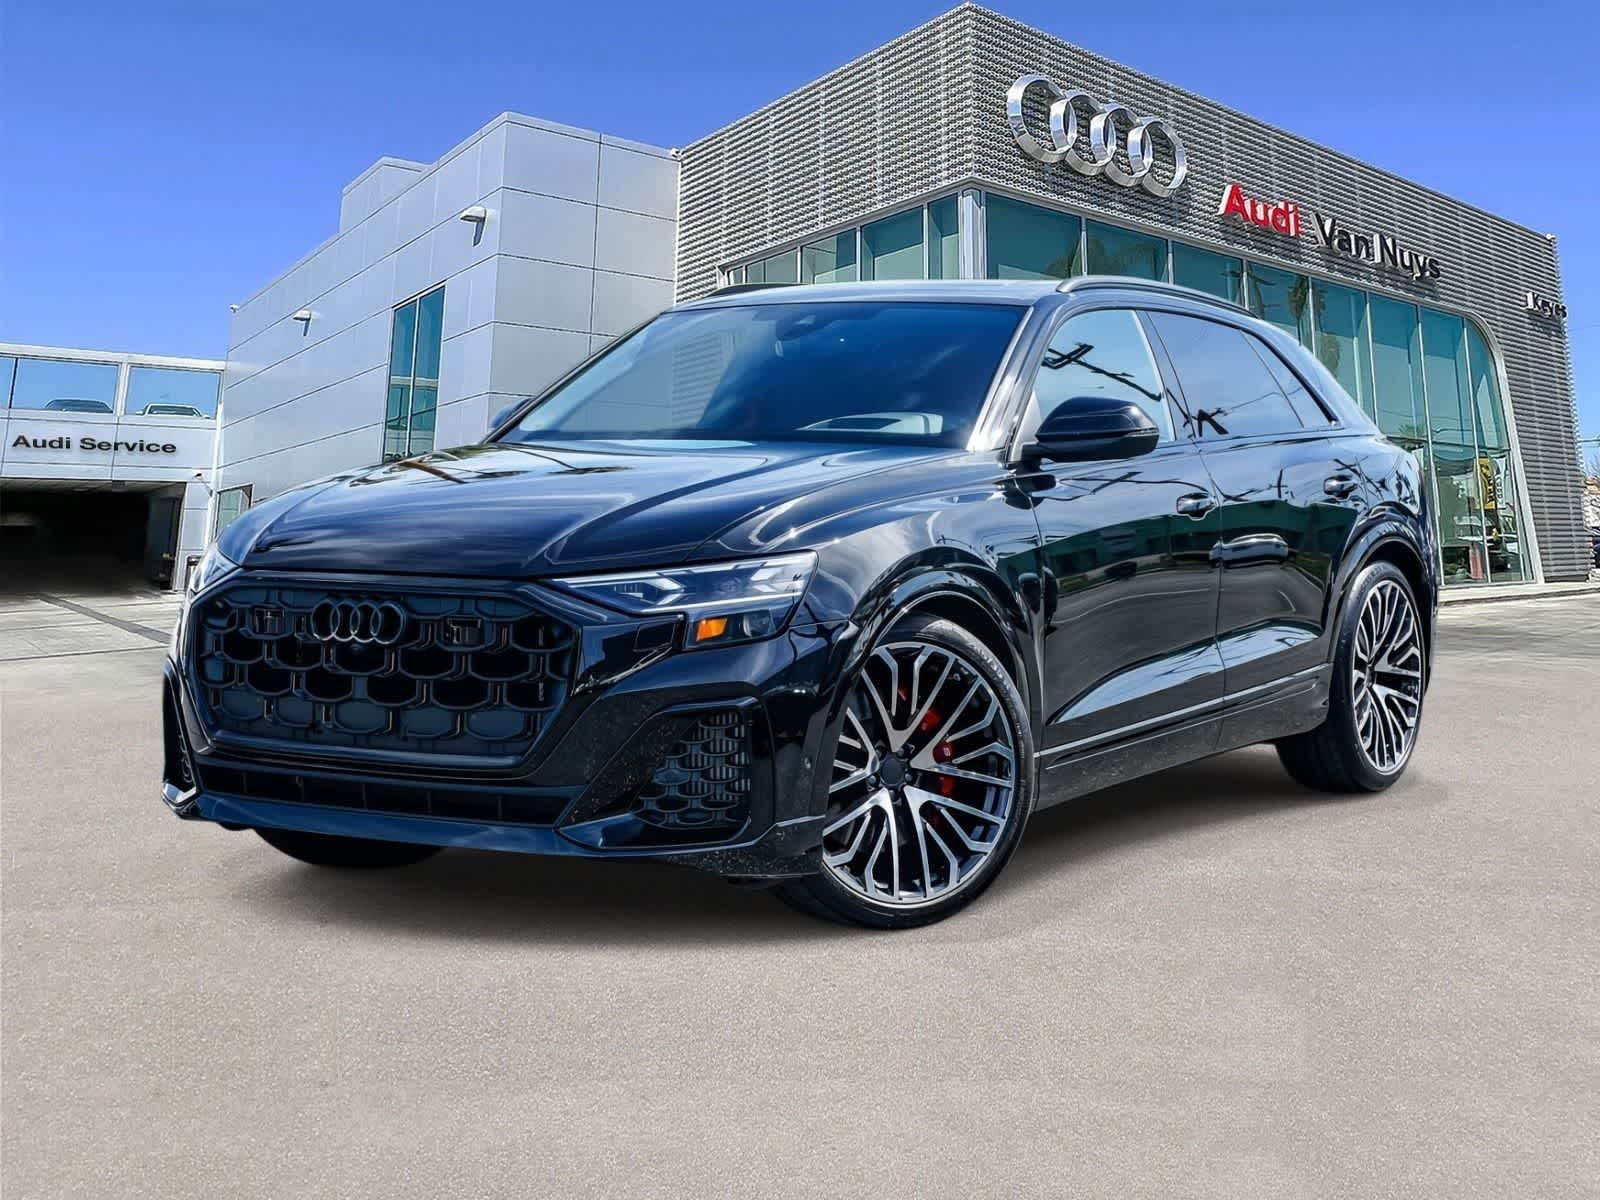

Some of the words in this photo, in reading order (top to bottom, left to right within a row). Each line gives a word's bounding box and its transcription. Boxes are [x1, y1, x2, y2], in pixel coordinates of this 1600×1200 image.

[1217, 183, 1301, 238] Audi
[1311, 212, 1371, 259] Van
[1373, 233, 1441, 279] Nuys
[1527, 292, 1567, 319] Keyes
[12, 435, 71, 449] Audi
[79, 437, 177, 453] Service
